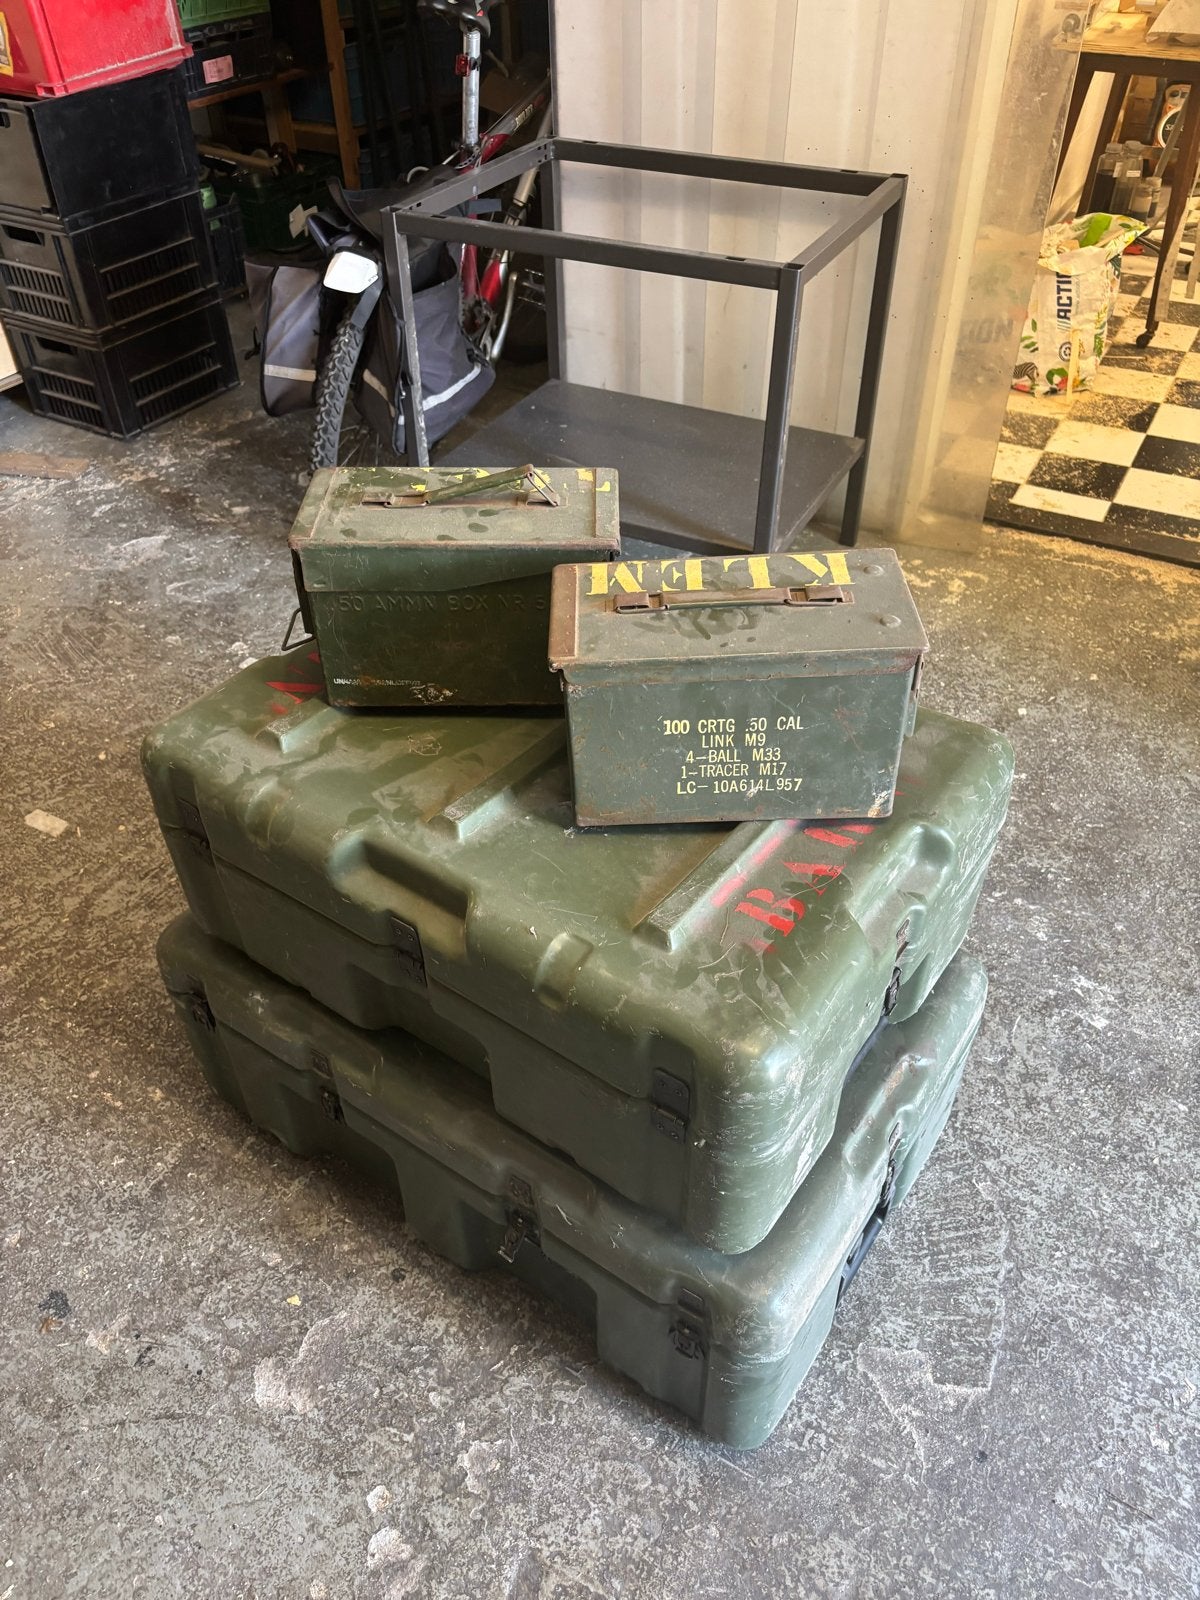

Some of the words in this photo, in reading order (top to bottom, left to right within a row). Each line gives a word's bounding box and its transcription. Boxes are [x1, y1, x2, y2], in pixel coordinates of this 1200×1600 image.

[586, 552, 855, 596] KLEM
[663, 719, 690, 736] 100
[698, 719, 736, 734] CRTG
[745, 717, 768, 732] .50
[776, 716, 804, 731] CAL
[701, 734, 735, 749] LINK
[745, 733, 767, 747] M9
[752, 748, 781, 762] M33
[759, 762, 787, 776] M17
